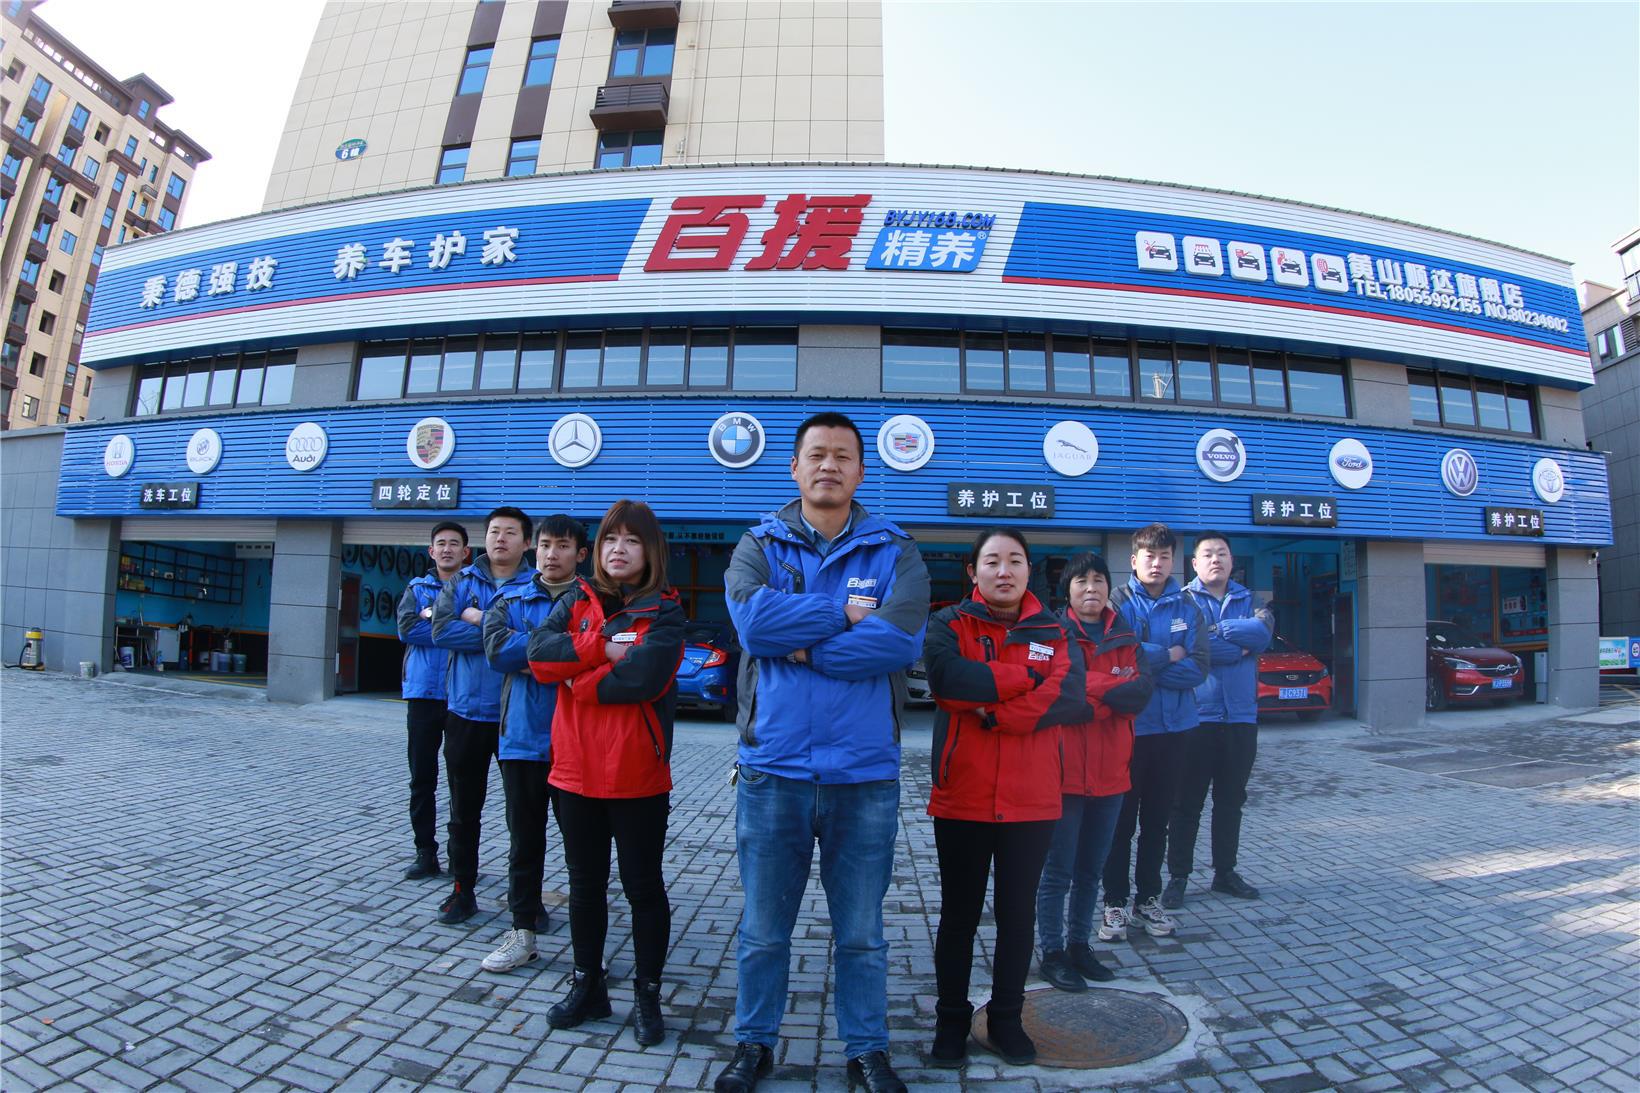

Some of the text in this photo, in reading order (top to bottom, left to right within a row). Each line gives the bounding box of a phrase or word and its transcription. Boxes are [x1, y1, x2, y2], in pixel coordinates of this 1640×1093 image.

[883, 209, 997, 230] BYJY168.COM
[643, 194, 872, 273] 百援
[880, 230, 977, 268] 精养
[140, 226, 520, 310] 秉德强技 养车护家
[1346, 252, 1524, 308] 黄山顺达旗舰店
[718, 417, 757, 432] BMW
[1341, 456, 1363, 467] Ford
[143, 487, 191, 503] 洗车工位
[378, 484, 452, 501] 四轮定位
[957, 489, 1048, 510] 养护工位
[1261, 499, 1332, 520] 养护工位
[1491, 512, 1540, 529] 养护工位
